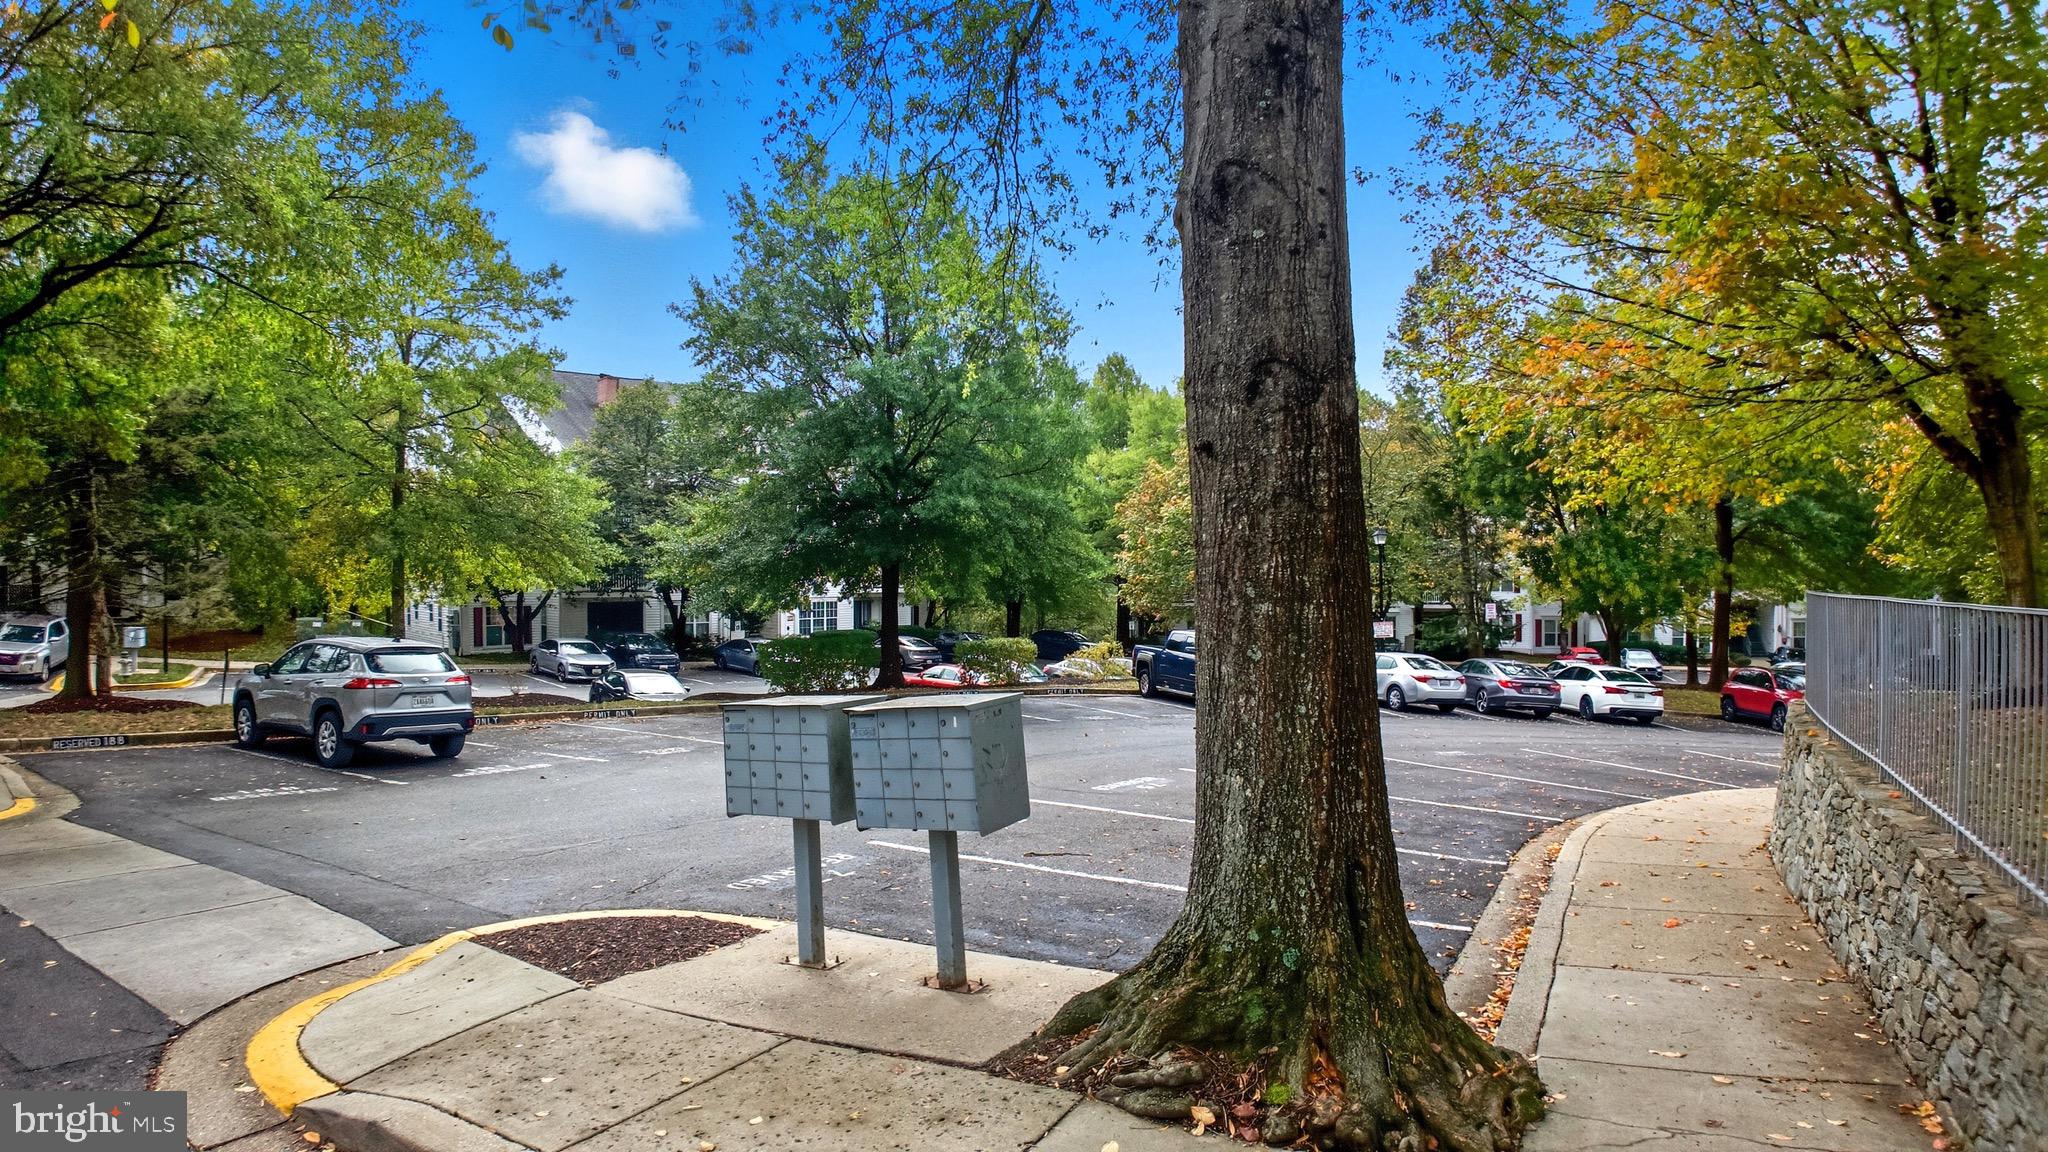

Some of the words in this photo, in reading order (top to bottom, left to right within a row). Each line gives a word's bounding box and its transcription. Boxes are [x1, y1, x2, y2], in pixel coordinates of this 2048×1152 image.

[584, 711, 611, 719] PERMIT
[616, 709, 637, 718] ONLY
[475, 716, 499, 725] ONLY
[53, 737, 101, 749] RESERVED
[103, 736, 125, 746] 188
[726, 853, 856, 889] RERVED
